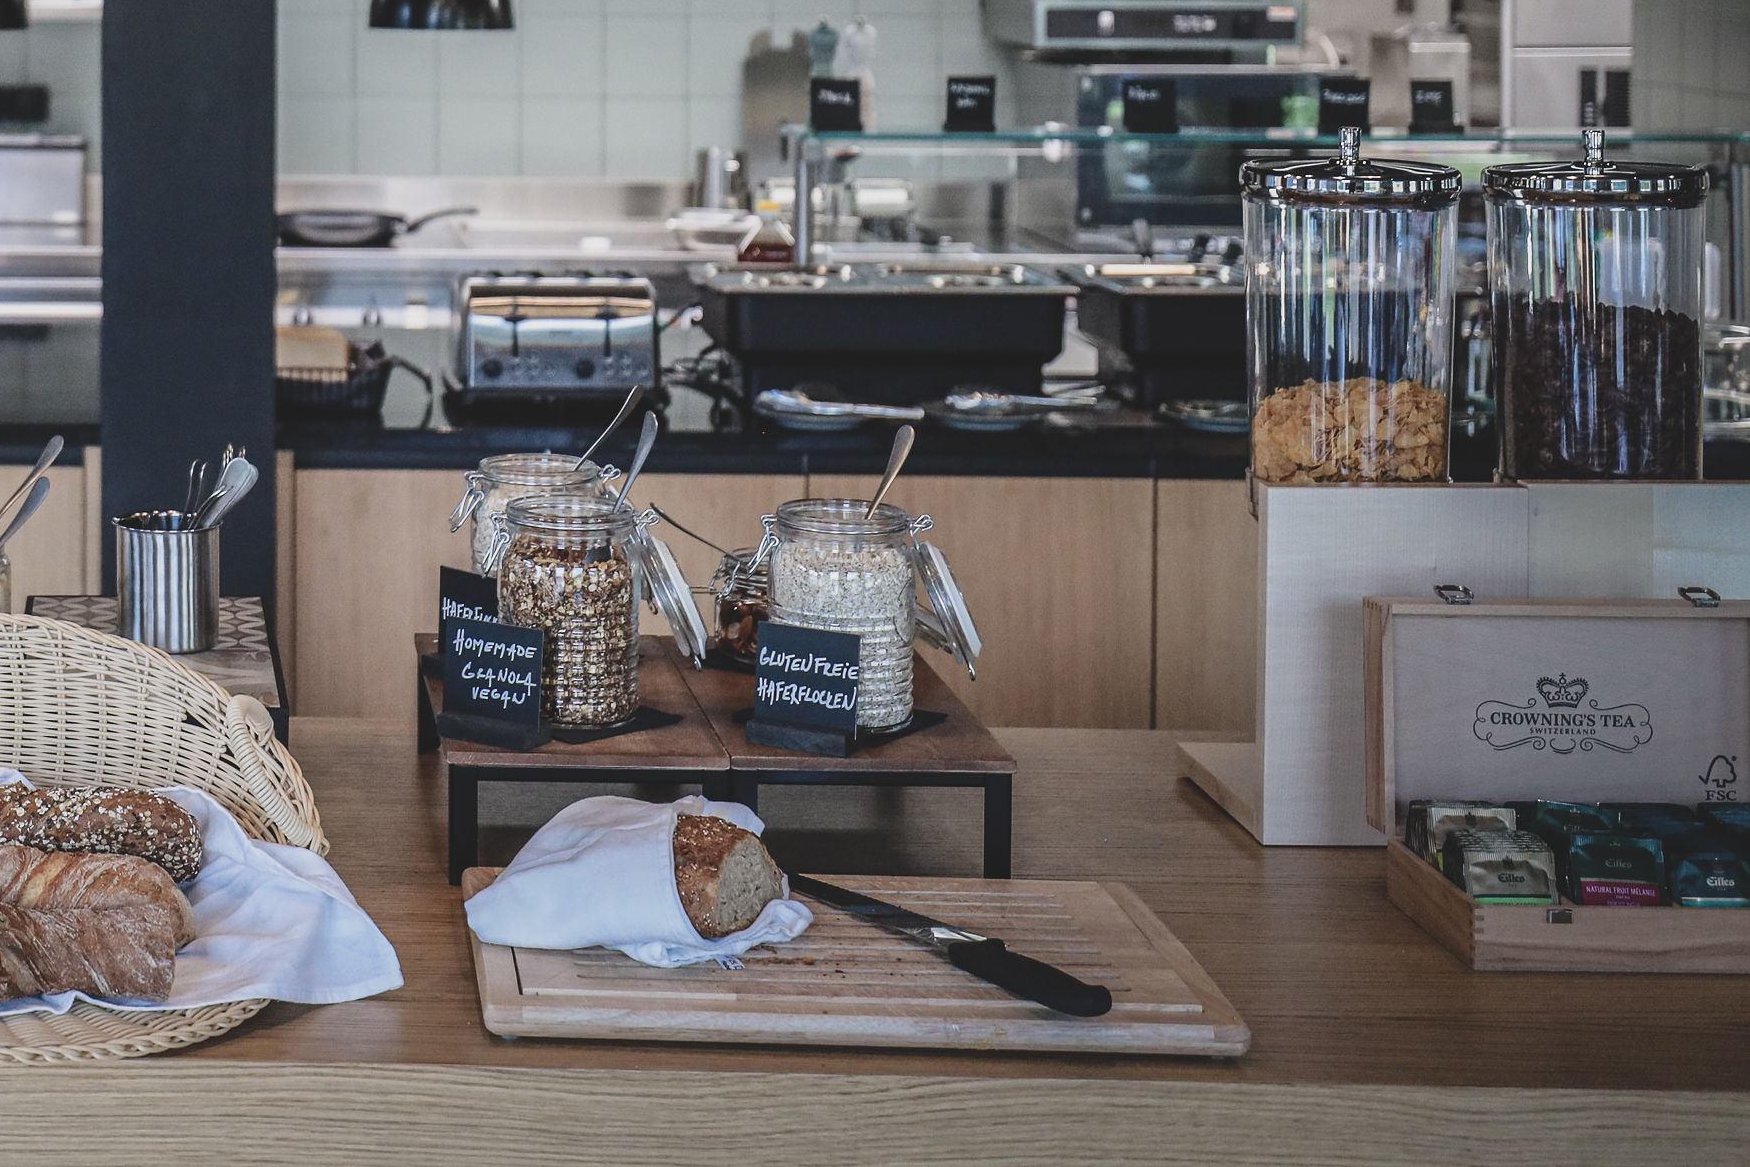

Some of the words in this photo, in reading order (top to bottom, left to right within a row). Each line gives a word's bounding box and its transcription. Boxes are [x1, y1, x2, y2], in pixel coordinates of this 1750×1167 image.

[453, 628, 537, 662] HOMEMADE
[461, 661, 537, 696] GRANOLA
[472, 686, 526, 709] VEGAN
[757, 677, 857, 711] HAFERFLOCKEN
[1490, 711, 1596, 728] CROWNING'S
[1600, 714, 1636, 728] TEA
[1529, 726, 1596, 736] SWITZERLAND
[1705, 789, 1737, 802] FSC
[1585, 885, 1612, 895] NATURAL
[1613, 886, 1630, 895] FRUIT
[1706, 876, 1735, 887] Eilles
